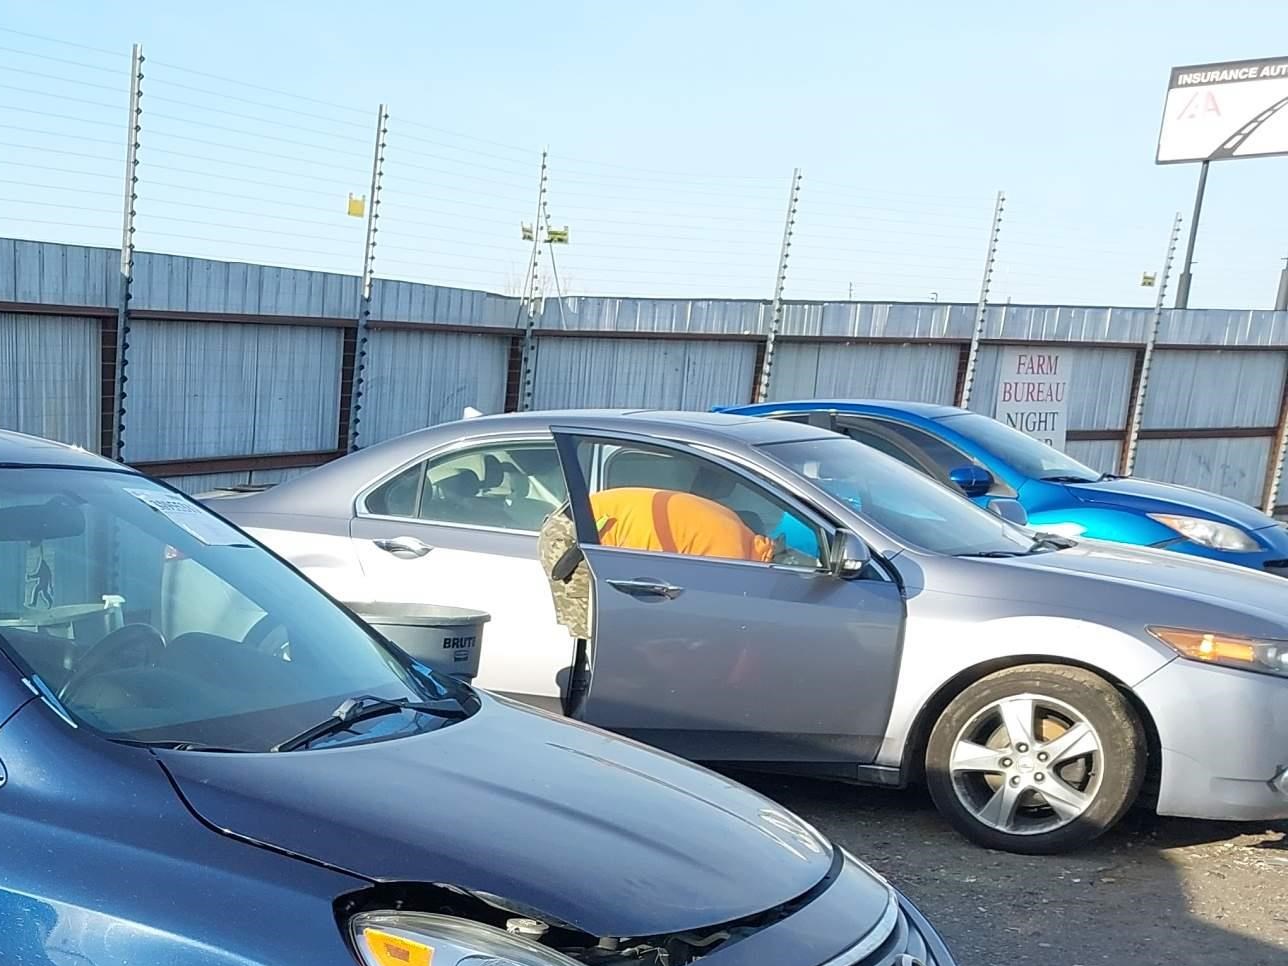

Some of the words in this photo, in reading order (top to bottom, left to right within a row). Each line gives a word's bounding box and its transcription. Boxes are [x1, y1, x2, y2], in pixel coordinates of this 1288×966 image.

[1177, 66, 1258, 86] INSURANCE
[1260, 63, 1288, 78] AUT
[1016, 354, 1060, 375] FARM
[1001, 382, 1066, 403] BUREAU
[1006, 411, 1059, 432] NIGHT
